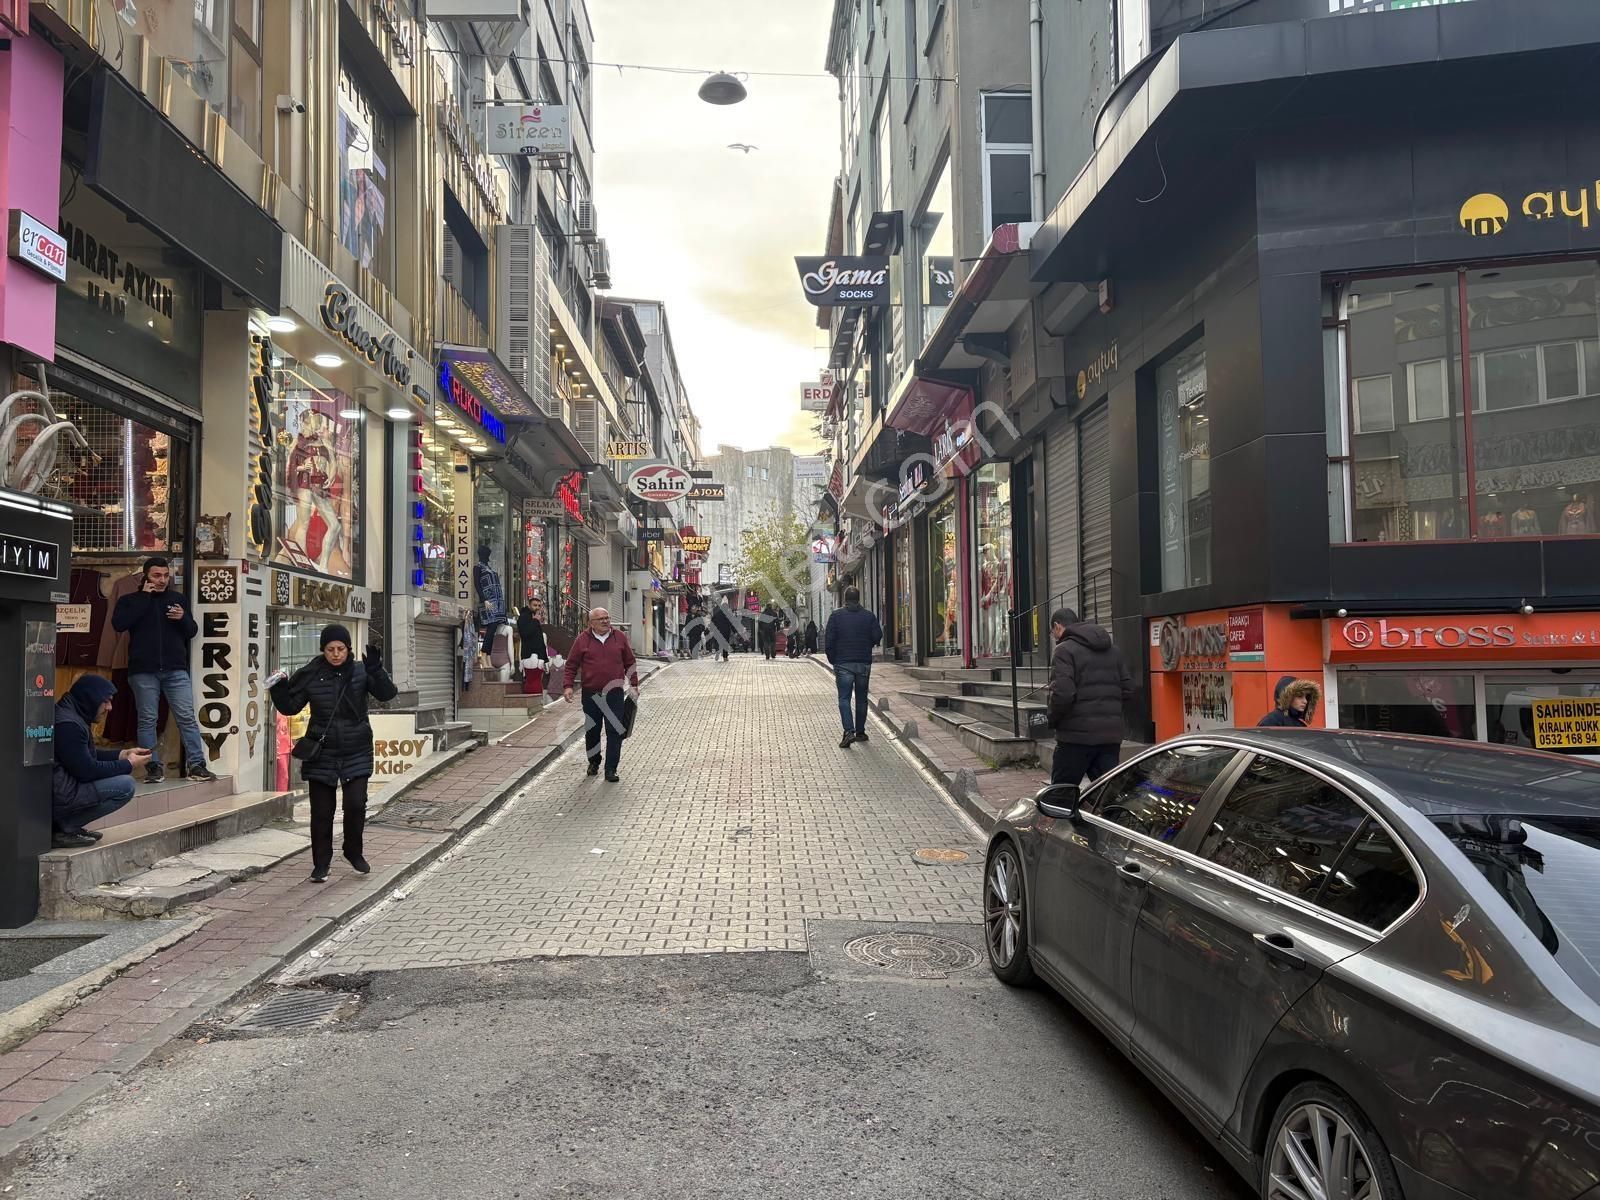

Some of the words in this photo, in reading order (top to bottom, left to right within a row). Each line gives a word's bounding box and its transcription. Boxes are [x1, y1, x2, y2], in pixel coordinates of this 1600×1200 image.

[495, 121, 562, 140] Sireen
[522, 147, 538, 155] 318
[21, 226, 65, 266] ercan
[802, 260, 887, 294] Gama
[839, 290, 874, 299] SOCKS
[319, 283, 371, 352] Blue
[453, 377, 481, 424] RUKO
[606, 442, 648, 455] ARTIS
[636, 477, 686, 492] Şahin
[701, 488, 724, 496] JOYA
[525, 500, 562, 509] SELMAN
[458, 515, 468, 554] RUKO
[683, 536, 711, 544] SWEET
[458, 559, 469, 599] MAYO
[351, 595, 367, 614] Kids
[1229, 615, 1250, 628] TARAKÇI
[1229, 630, 1246, 642] CAFER
[1376, 619, 1516, 648] bross
[1572, 631, 1586, 644] &
[199, 611, 233, 762] ERSOY
[246, 613, 259, 759] ERSOY
[1536, 700, 1600, 719] SAHİBİNDE
[1538, 719, 1573, 734] KİRALIK
[1575, 718, 1599, 732] DÜKK
[374, 739, 425, 758] RSOY
[1539, 734, 1563, 746] 0532
[1565, 733, 1584, 745] 168
[1585, 733, 1597, 744] 94
